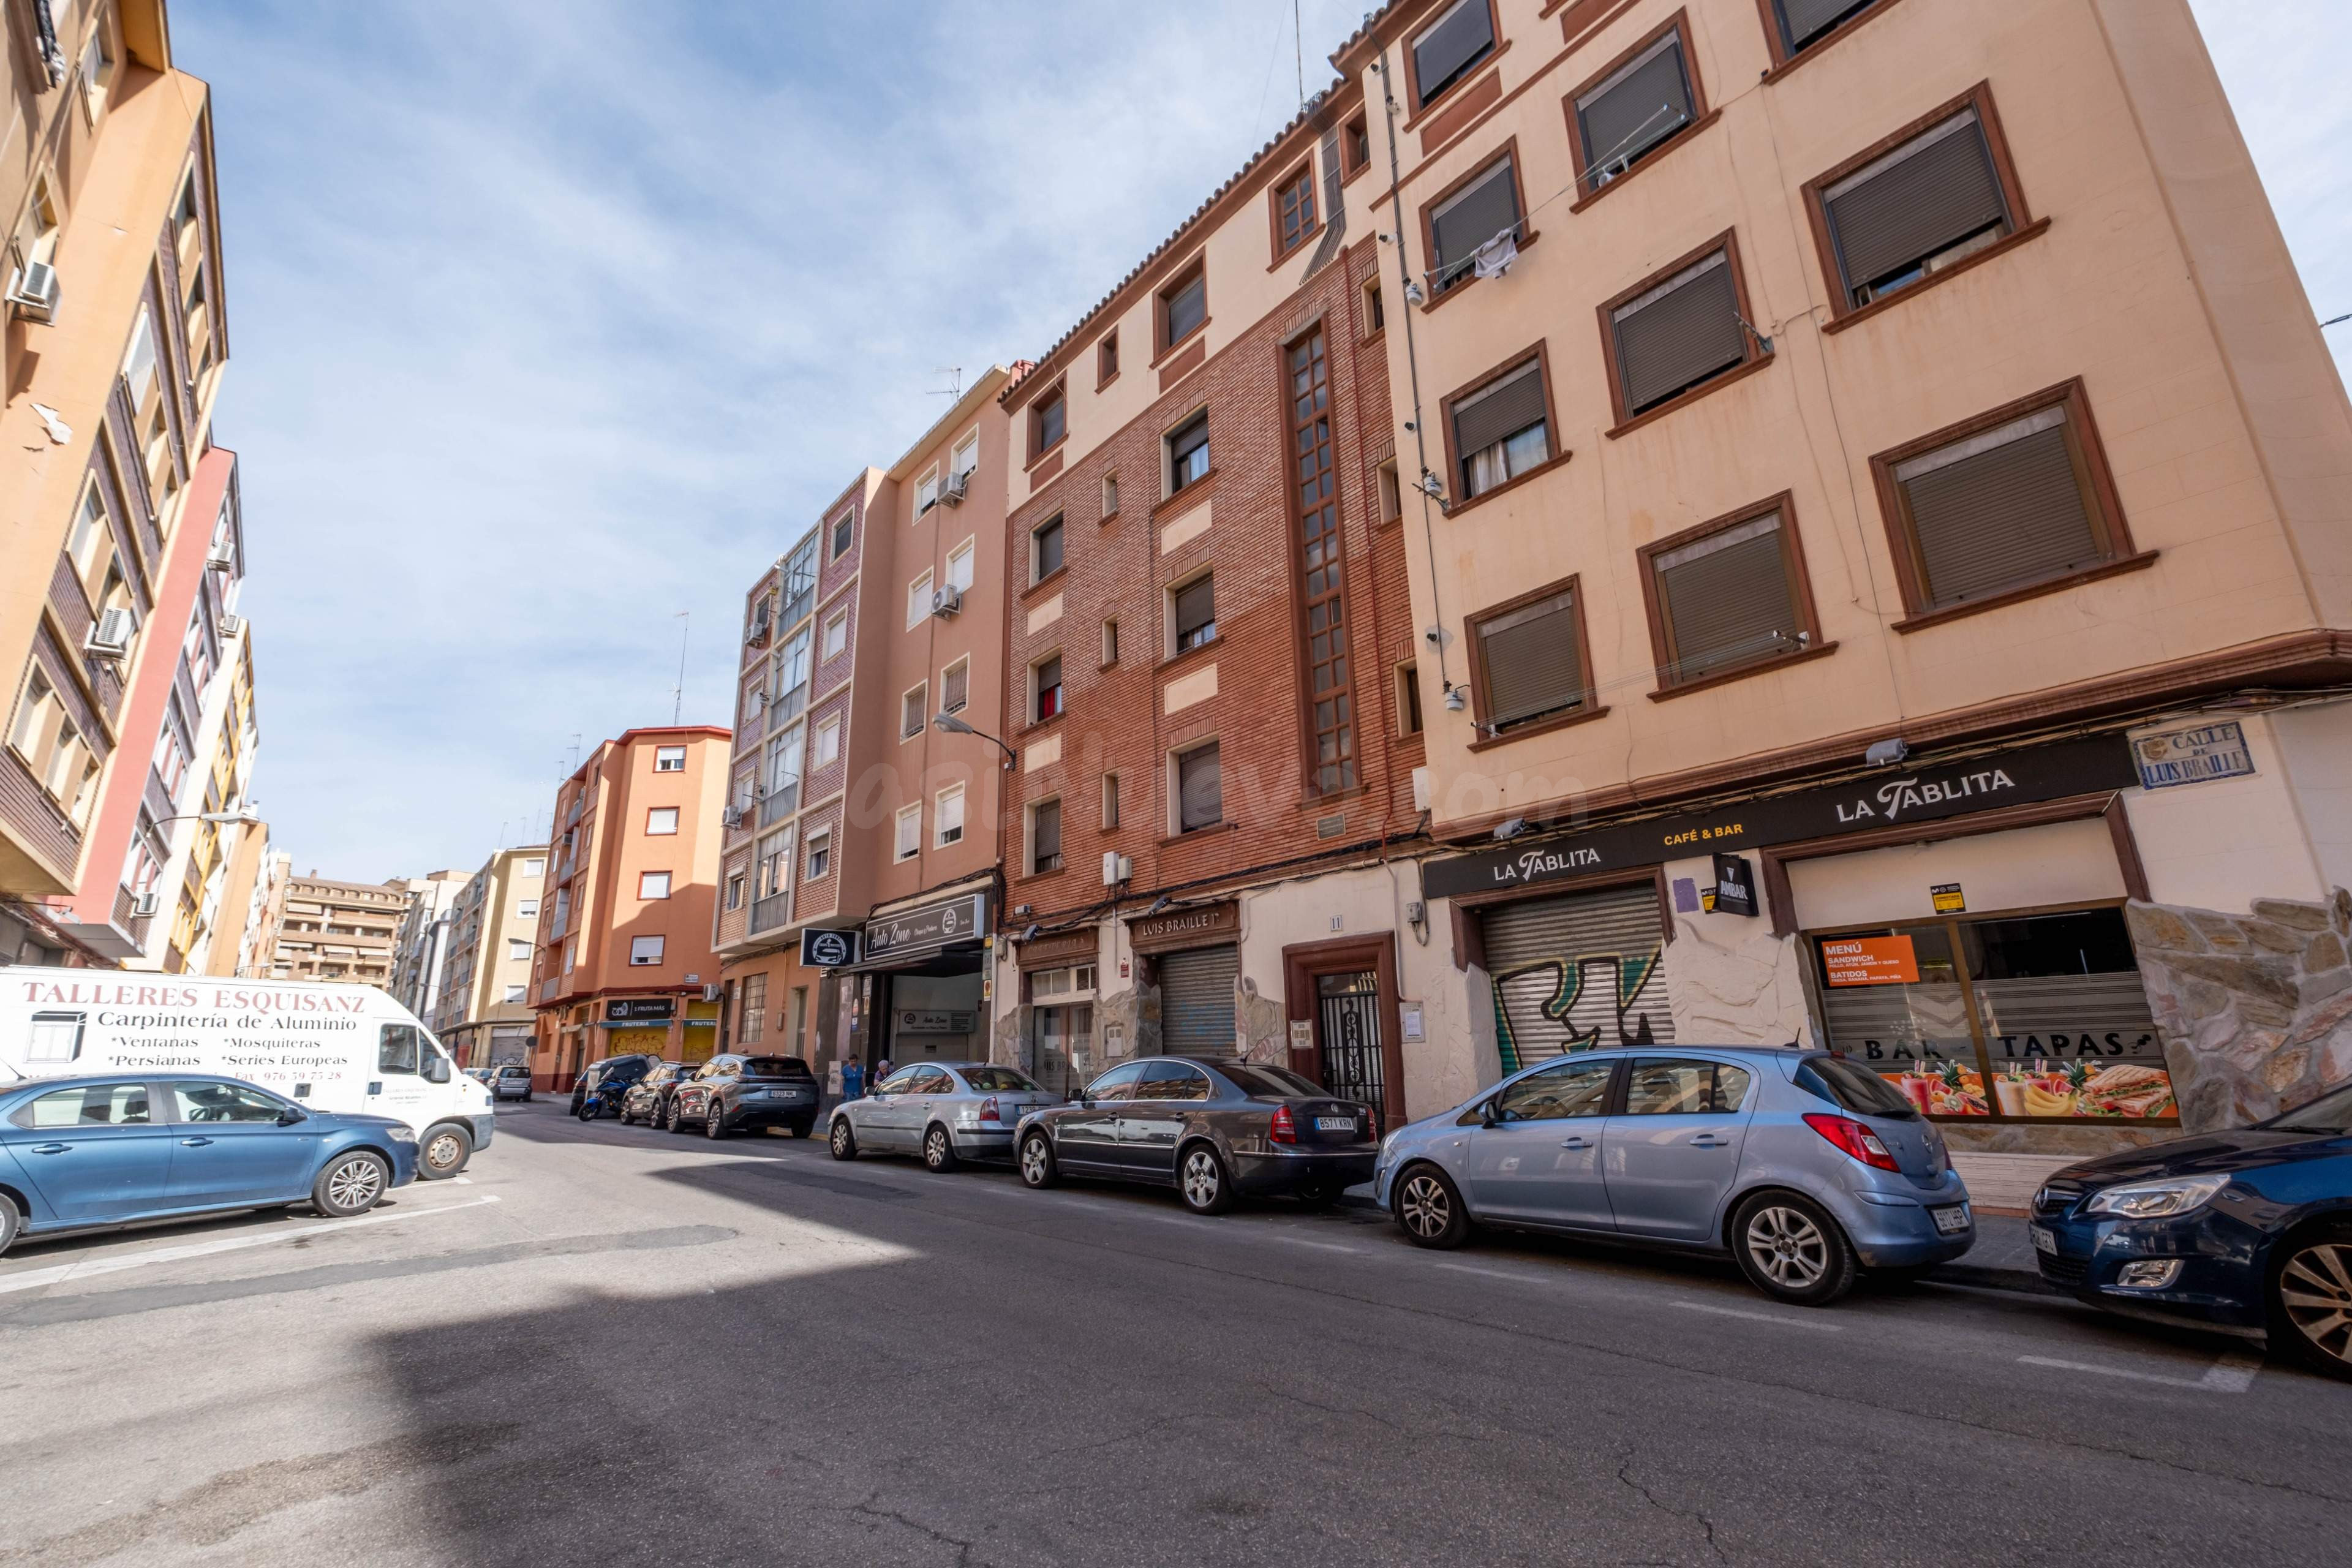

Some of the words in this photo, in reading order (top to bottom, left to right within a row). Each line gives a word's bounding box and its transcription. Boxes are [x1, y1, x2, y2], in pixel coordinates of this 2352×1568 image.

[2173, 726, 2236, 749] CALLE
[2146, 761, 2180, 783] LUIS
[2182, 750, 2245, 778] BRAILLE
[1836, 799, 1875, 823] LA
[1877, 769, 2015, 820] TABLITA
[1664, 829, 1698, 846] CAFÉ
[1702, 829, 1712, 839] &
[1715, 824, 1743, 837] BAR
[1494, 866, 1517, 881] LA
[1519, 848, 1601, 881] TABLITA
[1721, 880, 1748, 900] AMBAR
[1143, 922, 1163, 936] LUIS
[1167, 913, 1208, 932] BRAILLE
[1332, 918, 1340, 929] 11
[870, 928, 888, 949] Auto
[889, 922, 911, 946] Zone
[1825, 941, 1862, 955] MENÚ
[1828, 955, 1874, 964] SANDWICH
[1830, 970, 1867, 979] BATIDOS
[22, 982, 198, 1007] TALLERES
[214, 990, 365, 1015] ESQUISANZ
[98, 1011, 227, 1030] Carpintería
[237, 1015, 262, 1029] de
[271, 1016, 356, 1030] Aluminio
[1998, 1031, 2125, 1058] TAPAS
[281, 1055, 347, 1067] Europeas
[264, 1072, 285, 1081] 976
[1319, 1118, 1338, 1128] 8571
[1338, 1118, 1351, 1128] KRN
